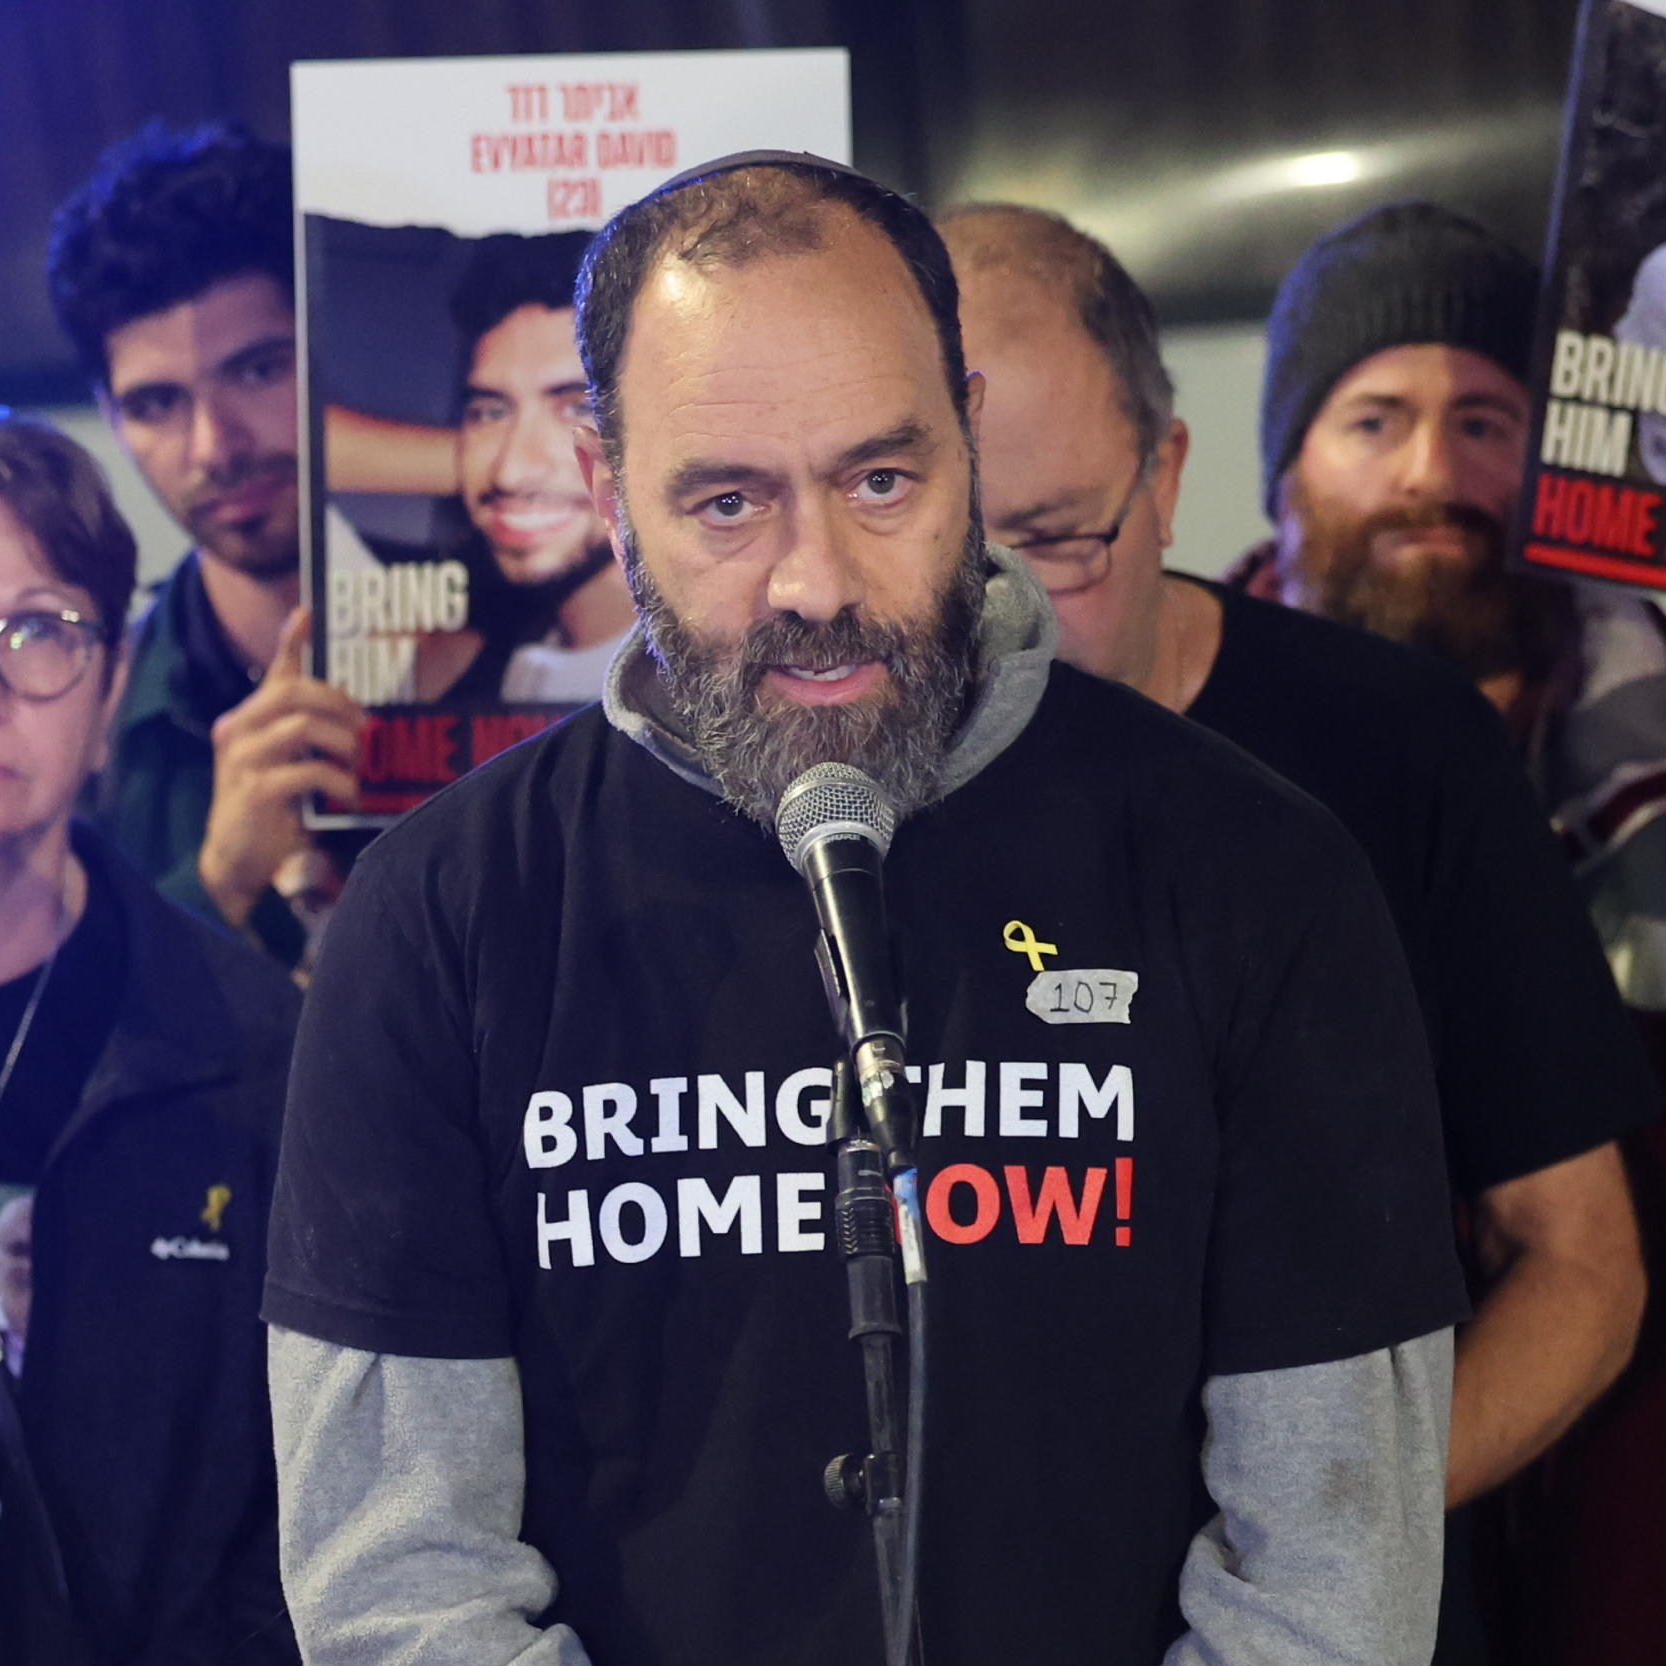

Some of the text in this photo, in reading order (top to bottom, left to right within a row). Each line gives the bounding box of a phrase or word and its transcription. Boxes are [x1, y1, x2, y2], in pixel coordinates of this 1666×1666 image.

[1541, 399, 1632, 477] HIM
[1533, 473, 1662, 556] HOME
[328, 560, 469, 637] BRING
[359, 715, 459, 782] OME
[1050, 981, 1117, 1013] 107
[524, 1067, 834, 1169] BRING
[538, 1157, 1133, 1269] HOME OW!
